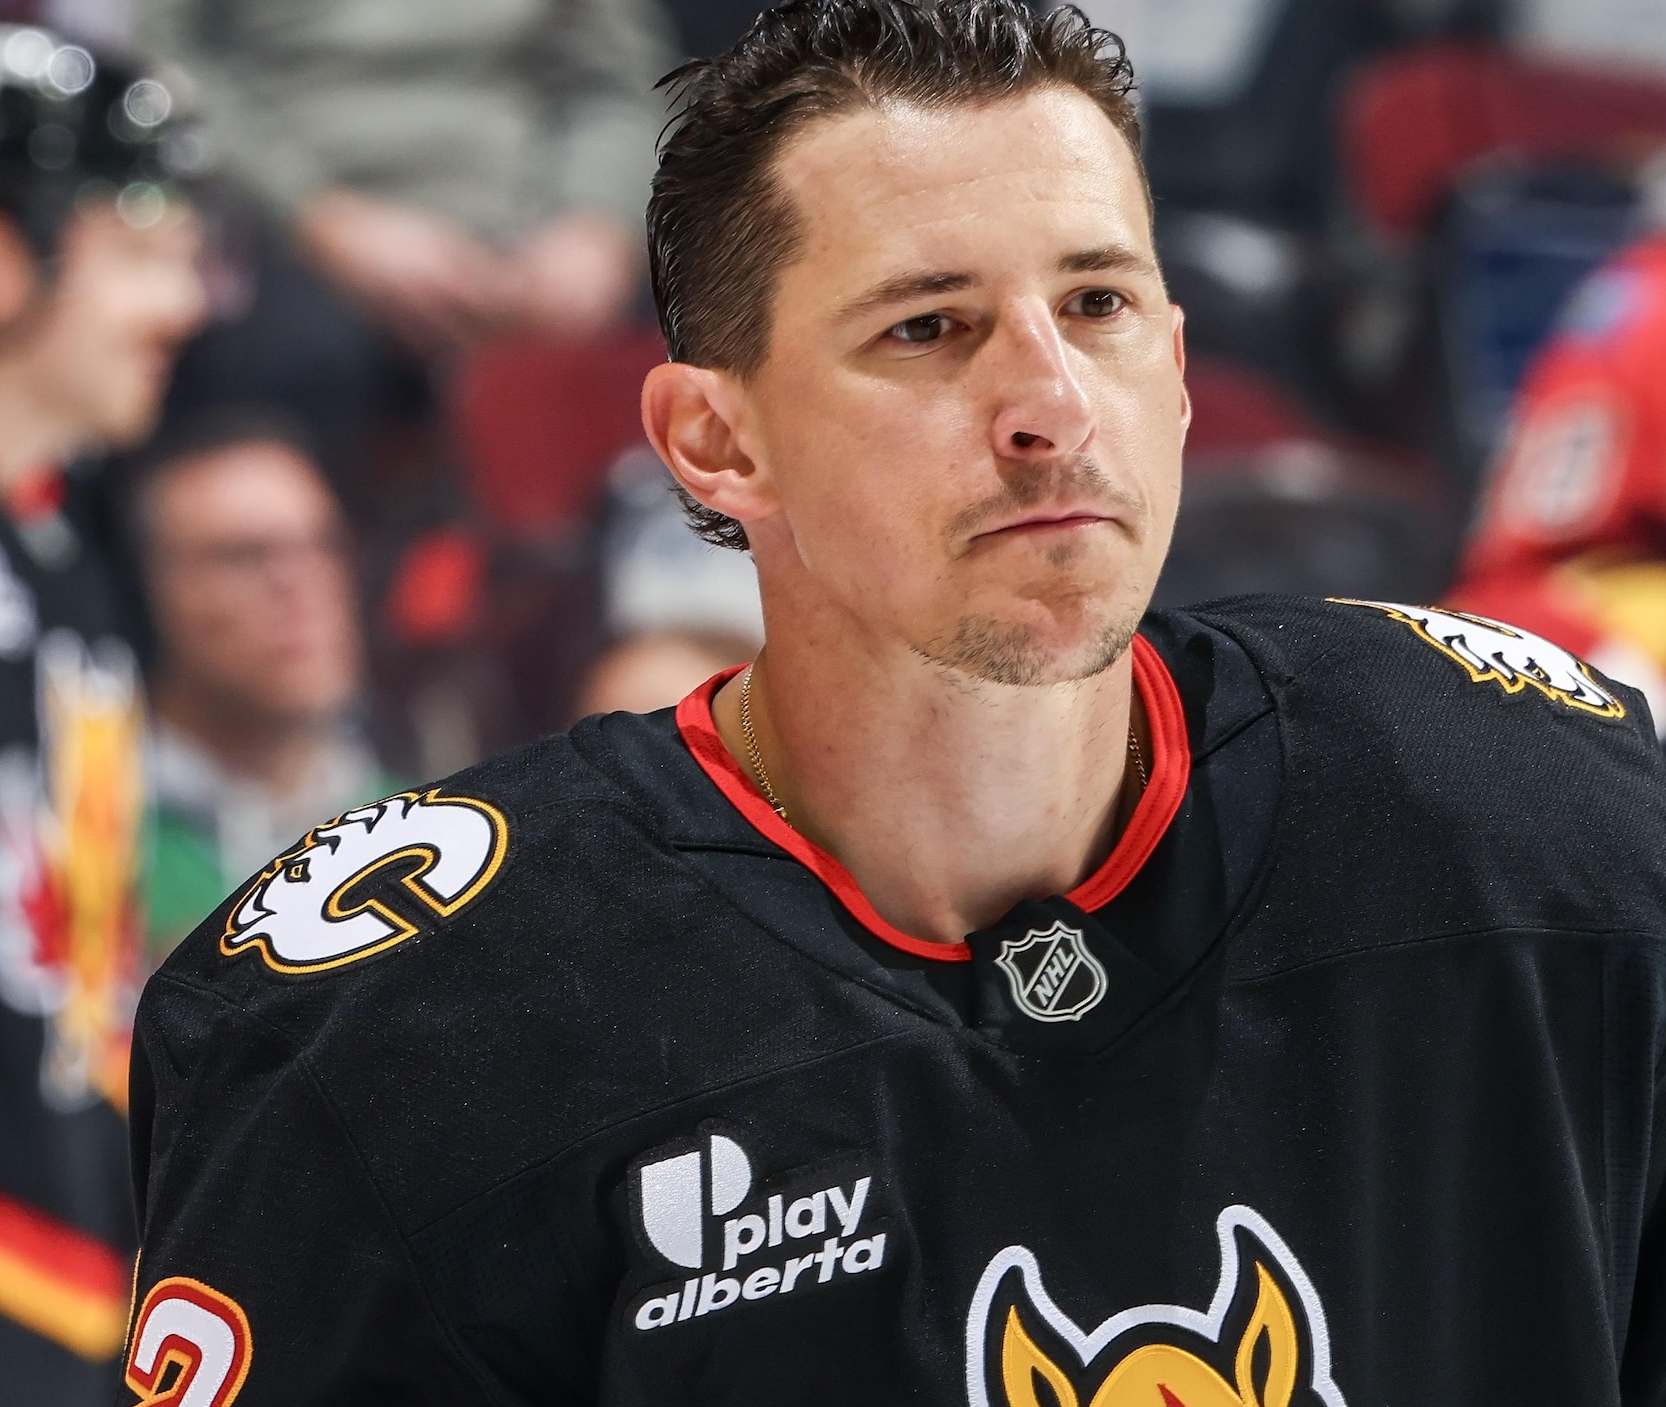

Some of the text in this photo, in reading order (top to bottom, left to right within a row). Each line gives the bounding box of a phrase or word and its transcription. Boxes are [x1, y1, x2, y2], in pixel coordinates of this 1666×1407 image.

[1033, 947, 1074, 1007] NHL
[721, 1176, 872, 1272] play
[634, 1232, 887, 1331] alberta
